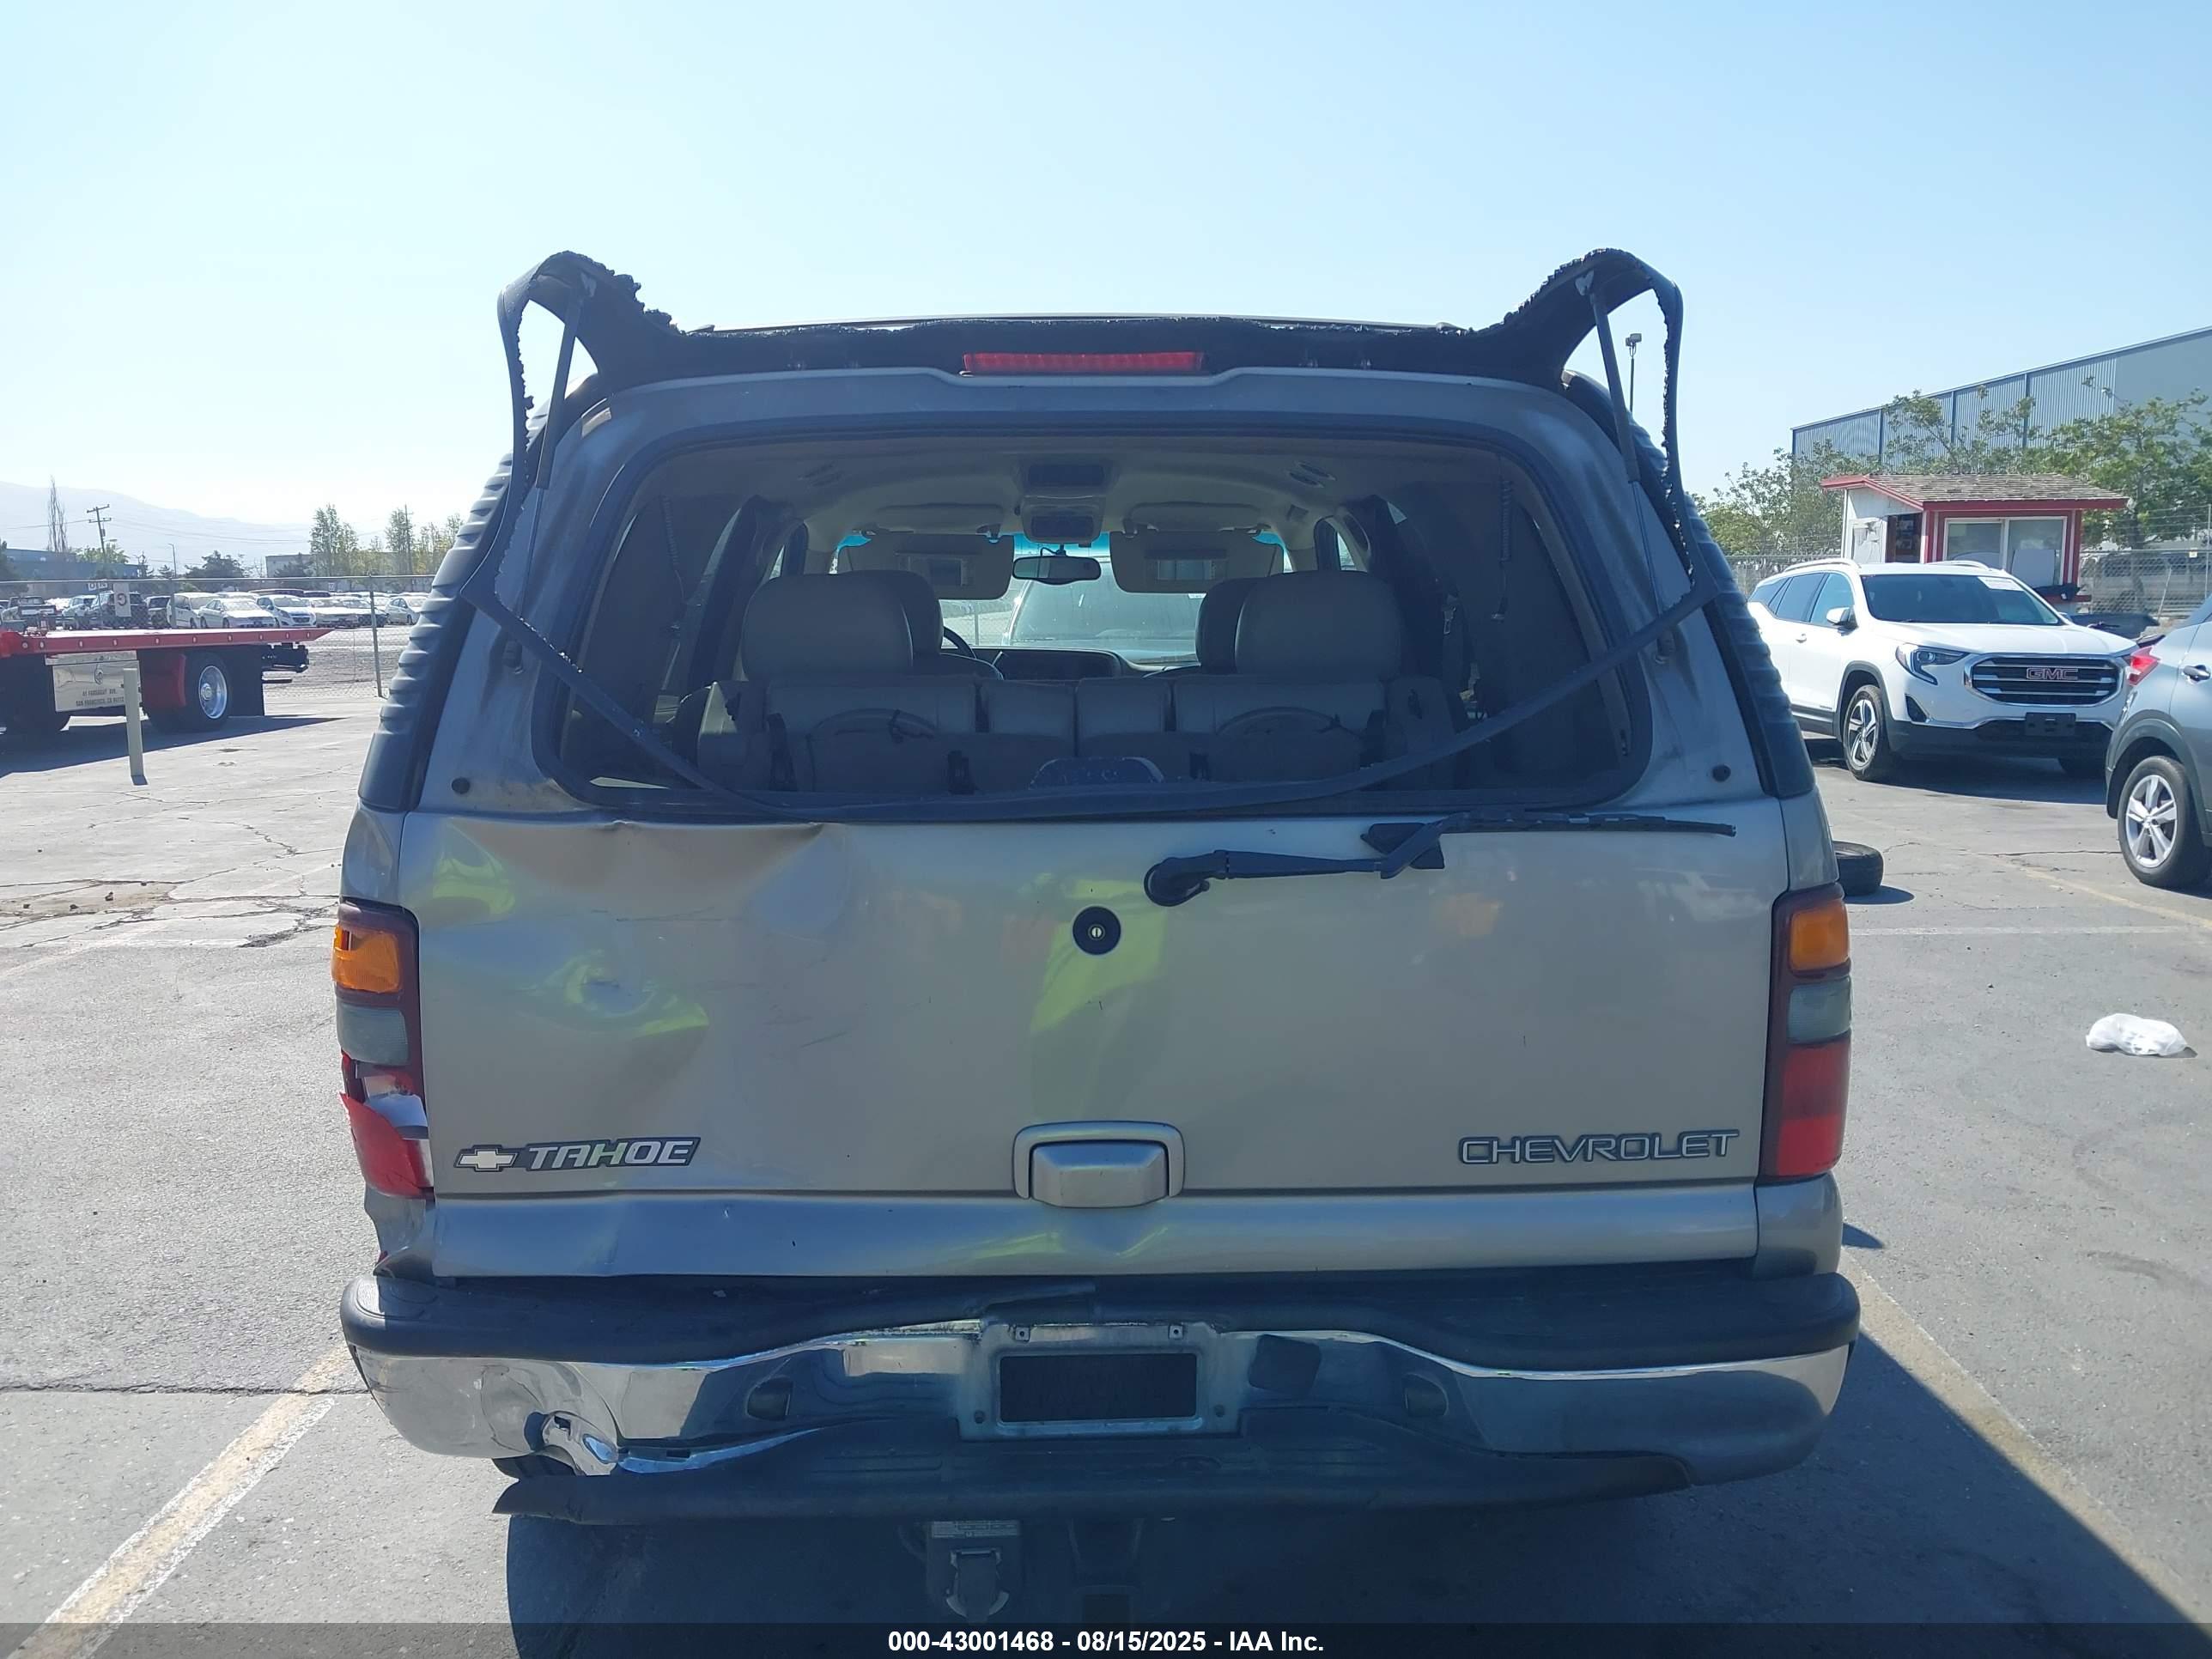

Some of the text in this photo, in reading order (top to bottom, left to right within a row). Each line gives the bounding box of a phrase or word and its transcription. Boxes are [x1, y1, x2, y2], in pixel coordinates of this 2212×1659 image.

[2027, 666, 2079, 680] GMC
[527, 1139, 694, 1170] TAHOE
[1460, 1131, 1739, 1164] CHEVROLET
